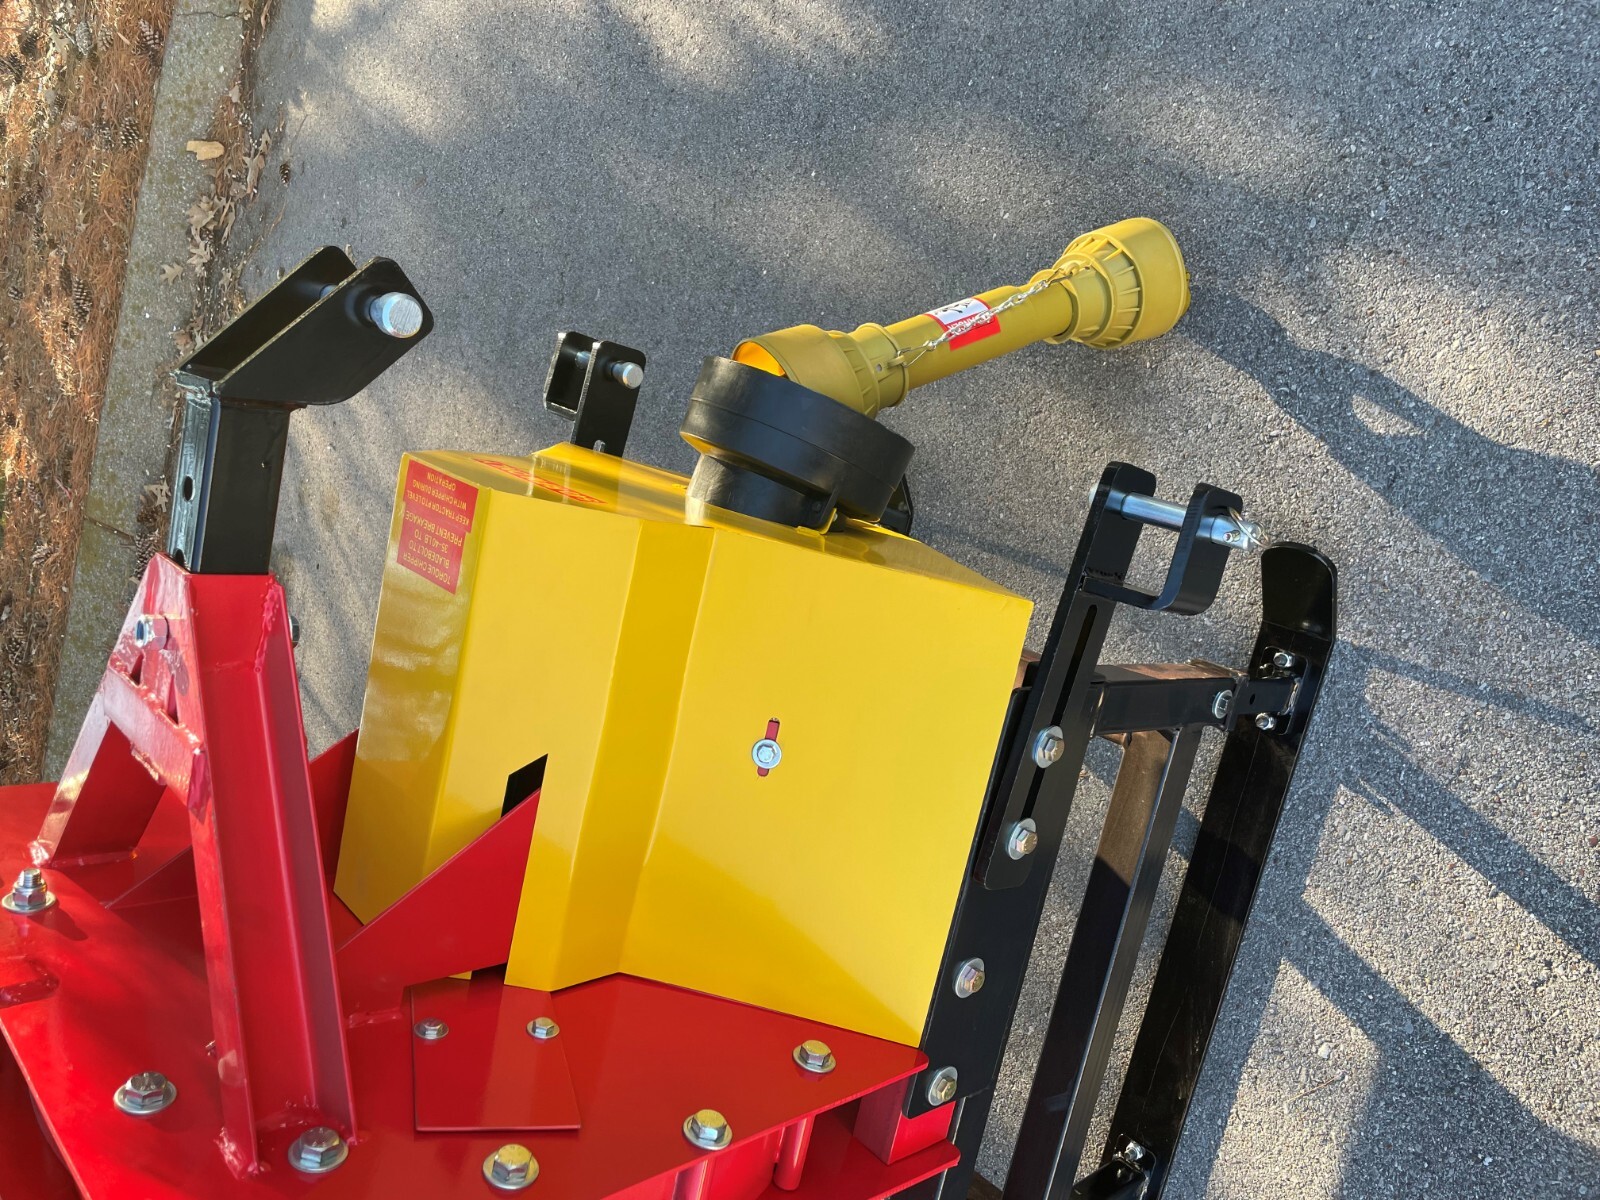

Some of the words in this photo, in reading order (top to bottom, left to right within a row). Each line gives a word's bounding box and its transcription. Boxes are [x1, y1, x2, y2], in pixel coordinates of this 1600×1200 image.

[413, 479, 431, 494] DURING
[427, 472, 456, 491] OPERATION
[407, 490, 421, 503] LEVEL
[432, 488, 453, 504] CHIPPER
[453, 498, 466, 510] WITH
[431, 502, 455, 519] TRACTOR
[405, 510, 435, 532] BREAKAGE
[456, 513, 469, 526] KEEP
[414, 528, 421, 539] TO
[435, 525, 462, 546] PREVENT
[409, 539, 416, 551] TO
[403, 550, 427, 571] CHIPPER
[427, 564, 451, 584] TORQUE
